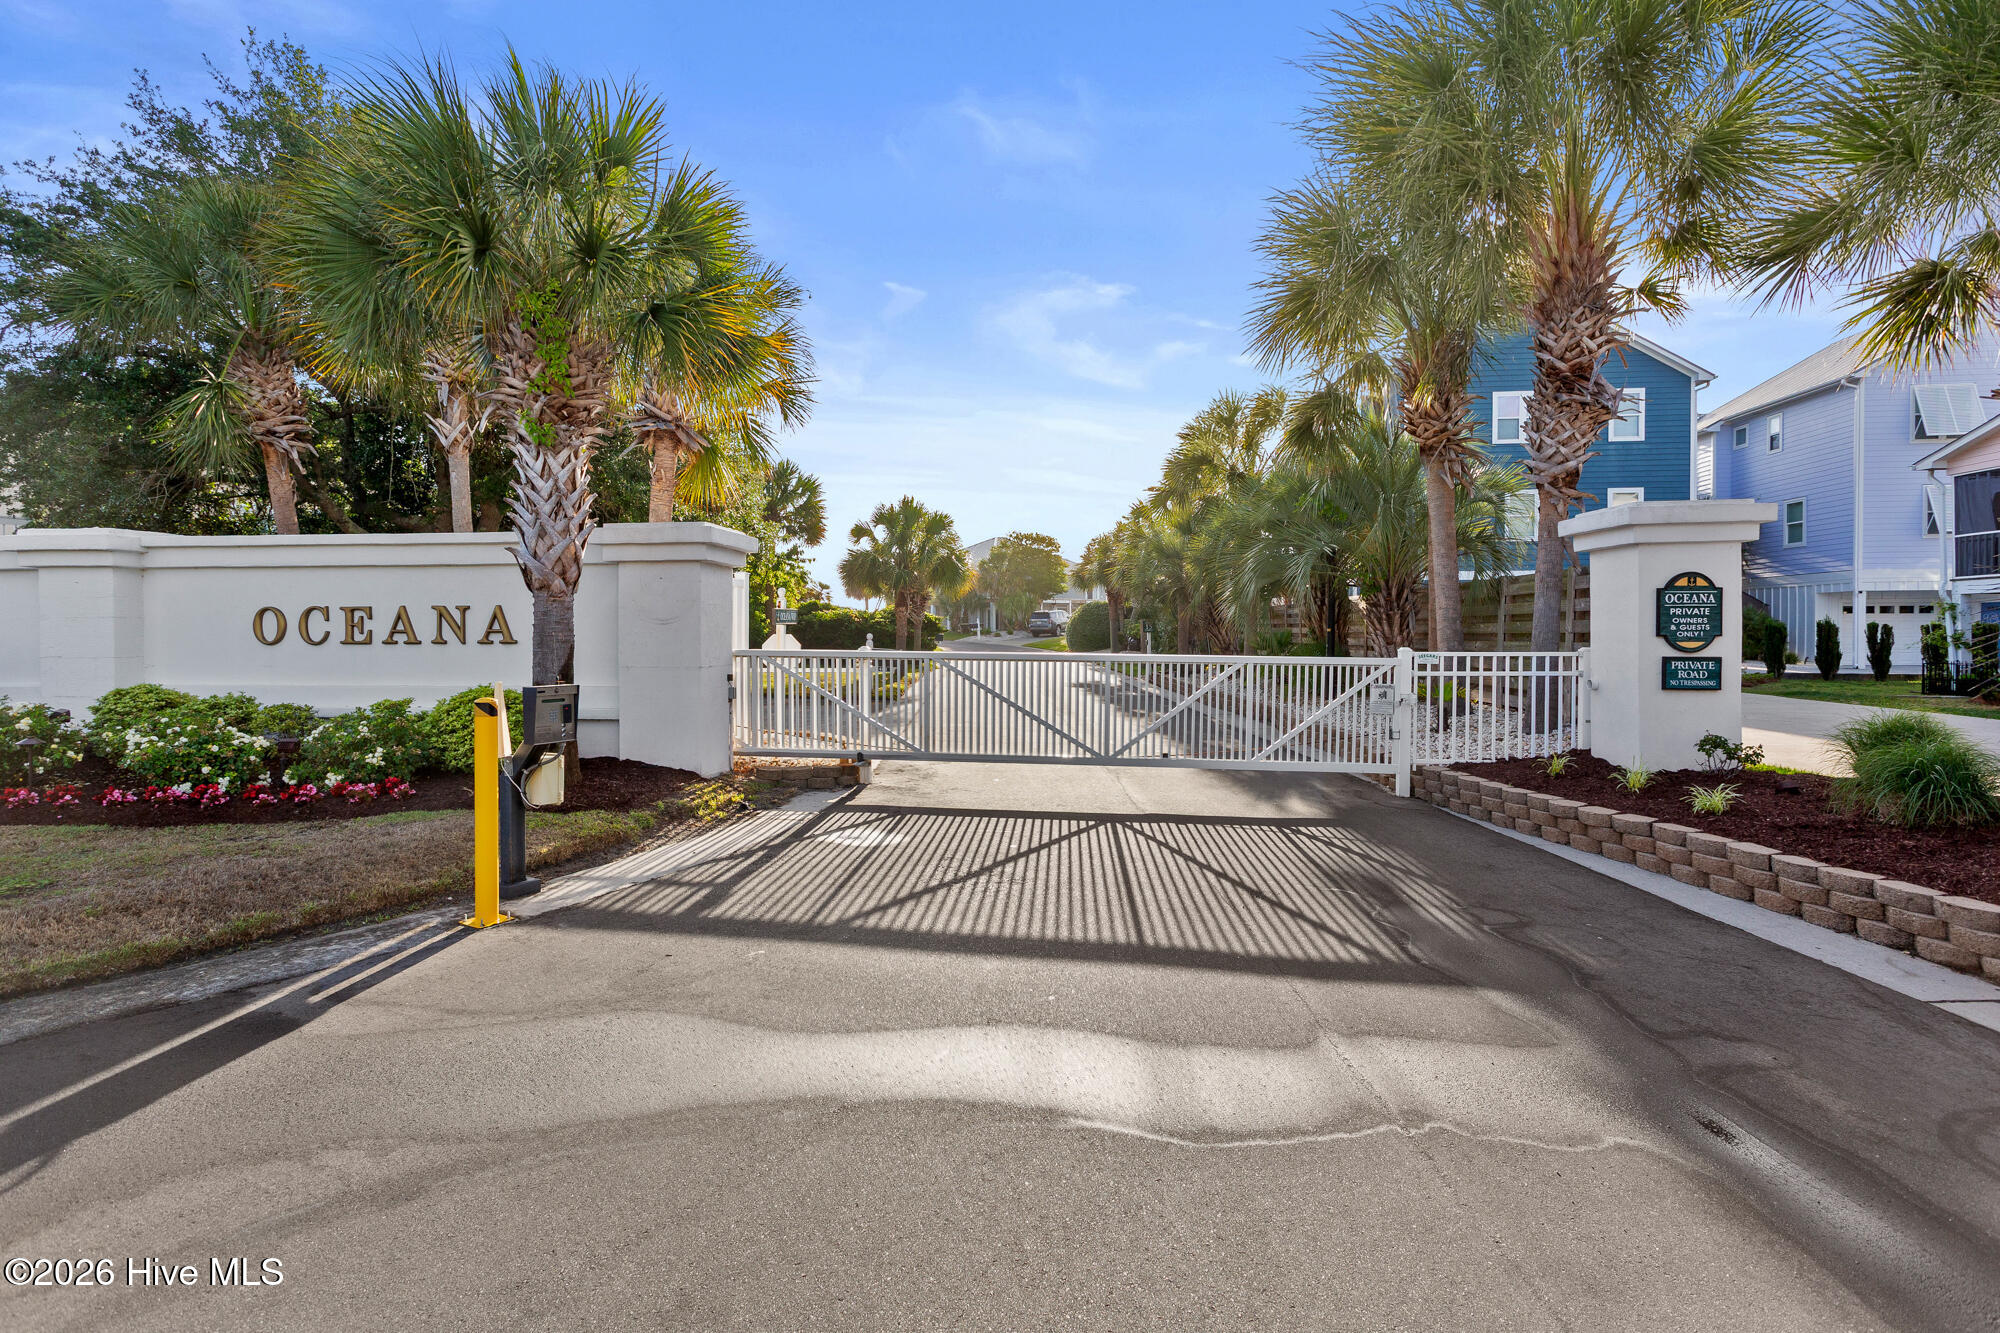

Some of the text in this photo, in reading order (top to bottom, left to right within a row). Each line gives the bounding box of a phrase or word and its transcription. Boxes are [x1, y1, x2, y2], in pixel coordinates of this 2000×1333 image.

[1665, 593, 1716, 603] OCEANA
[1670, 607, 1710, 615] PRIVATE
[252, 605, 518, 646] OCEANA
[1671, 661, 1716, 670] PRIVATE
[1678, 670, 1708, 679] ROAD
